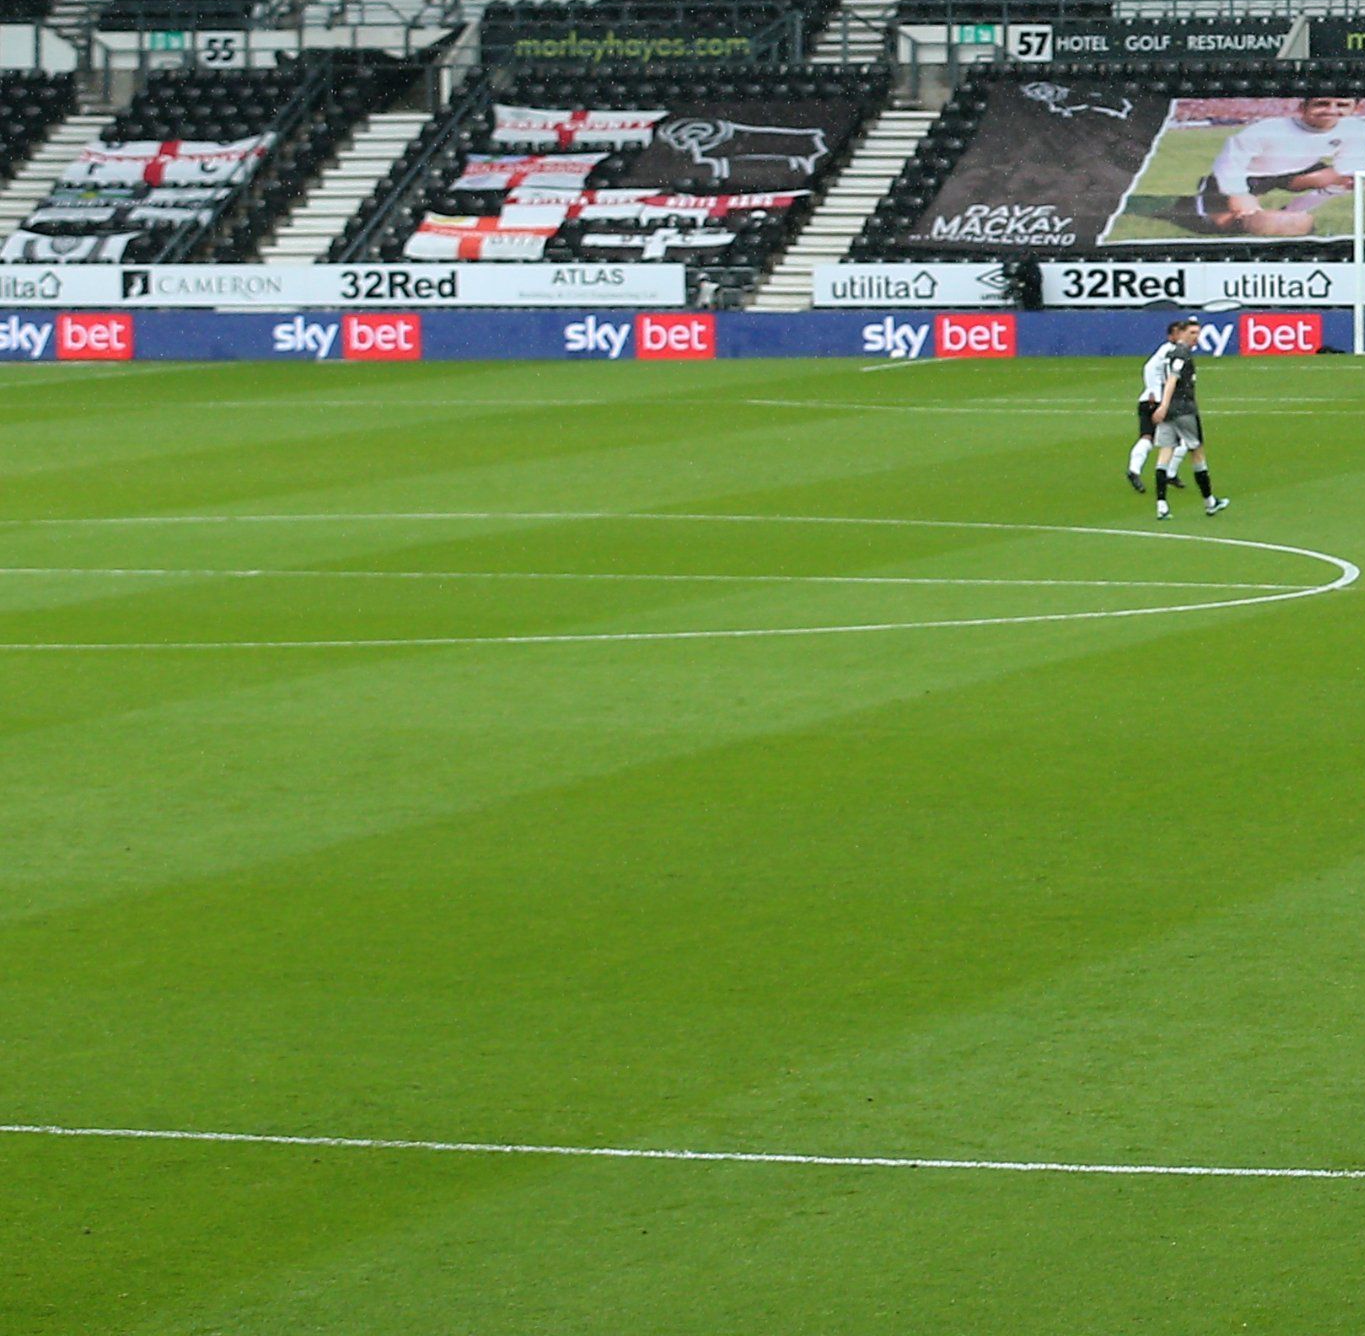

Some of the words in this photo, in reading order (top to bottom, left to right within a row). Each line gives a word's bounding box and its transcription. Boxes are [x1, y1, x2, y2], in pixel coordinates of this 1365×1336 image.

[203, 37, 236, 62] 55
[1018, 30, 1049, 57] 57
[1057, 35, 1109, 51] HOTEL
[1125, 34, 1171, 51] GOLF
[1187, 33, 1288, 50] RESTAURANT
[965, 204, 1057, 217] DAVE
[931, 216, 1073, 238] MACKAY
[158, 276, 284, 298] CAMERON
[340, 269, 459, 299] 32Red
[551, 268, 625, 285] ATLAS
[832, 272, 911, 300] utilita
[1063, 268, 1187, 298] 32Red
[1224, 270, 1304, 299] utilita
[0, 316, 52, 358] sky
[63, 318, 126, 351] bet
[273, 316, 339, 358] sky
[351, 318, 414, 351] bet
[564, 315, 630, 358] sky
[642, 318, 707, 351] bet
[862, 316, 930, 358] sky
[943, 319, 1008, 351] bet
[1189, 316, 1234, 357] ky
[1247, 318, 1313, 351] bet
